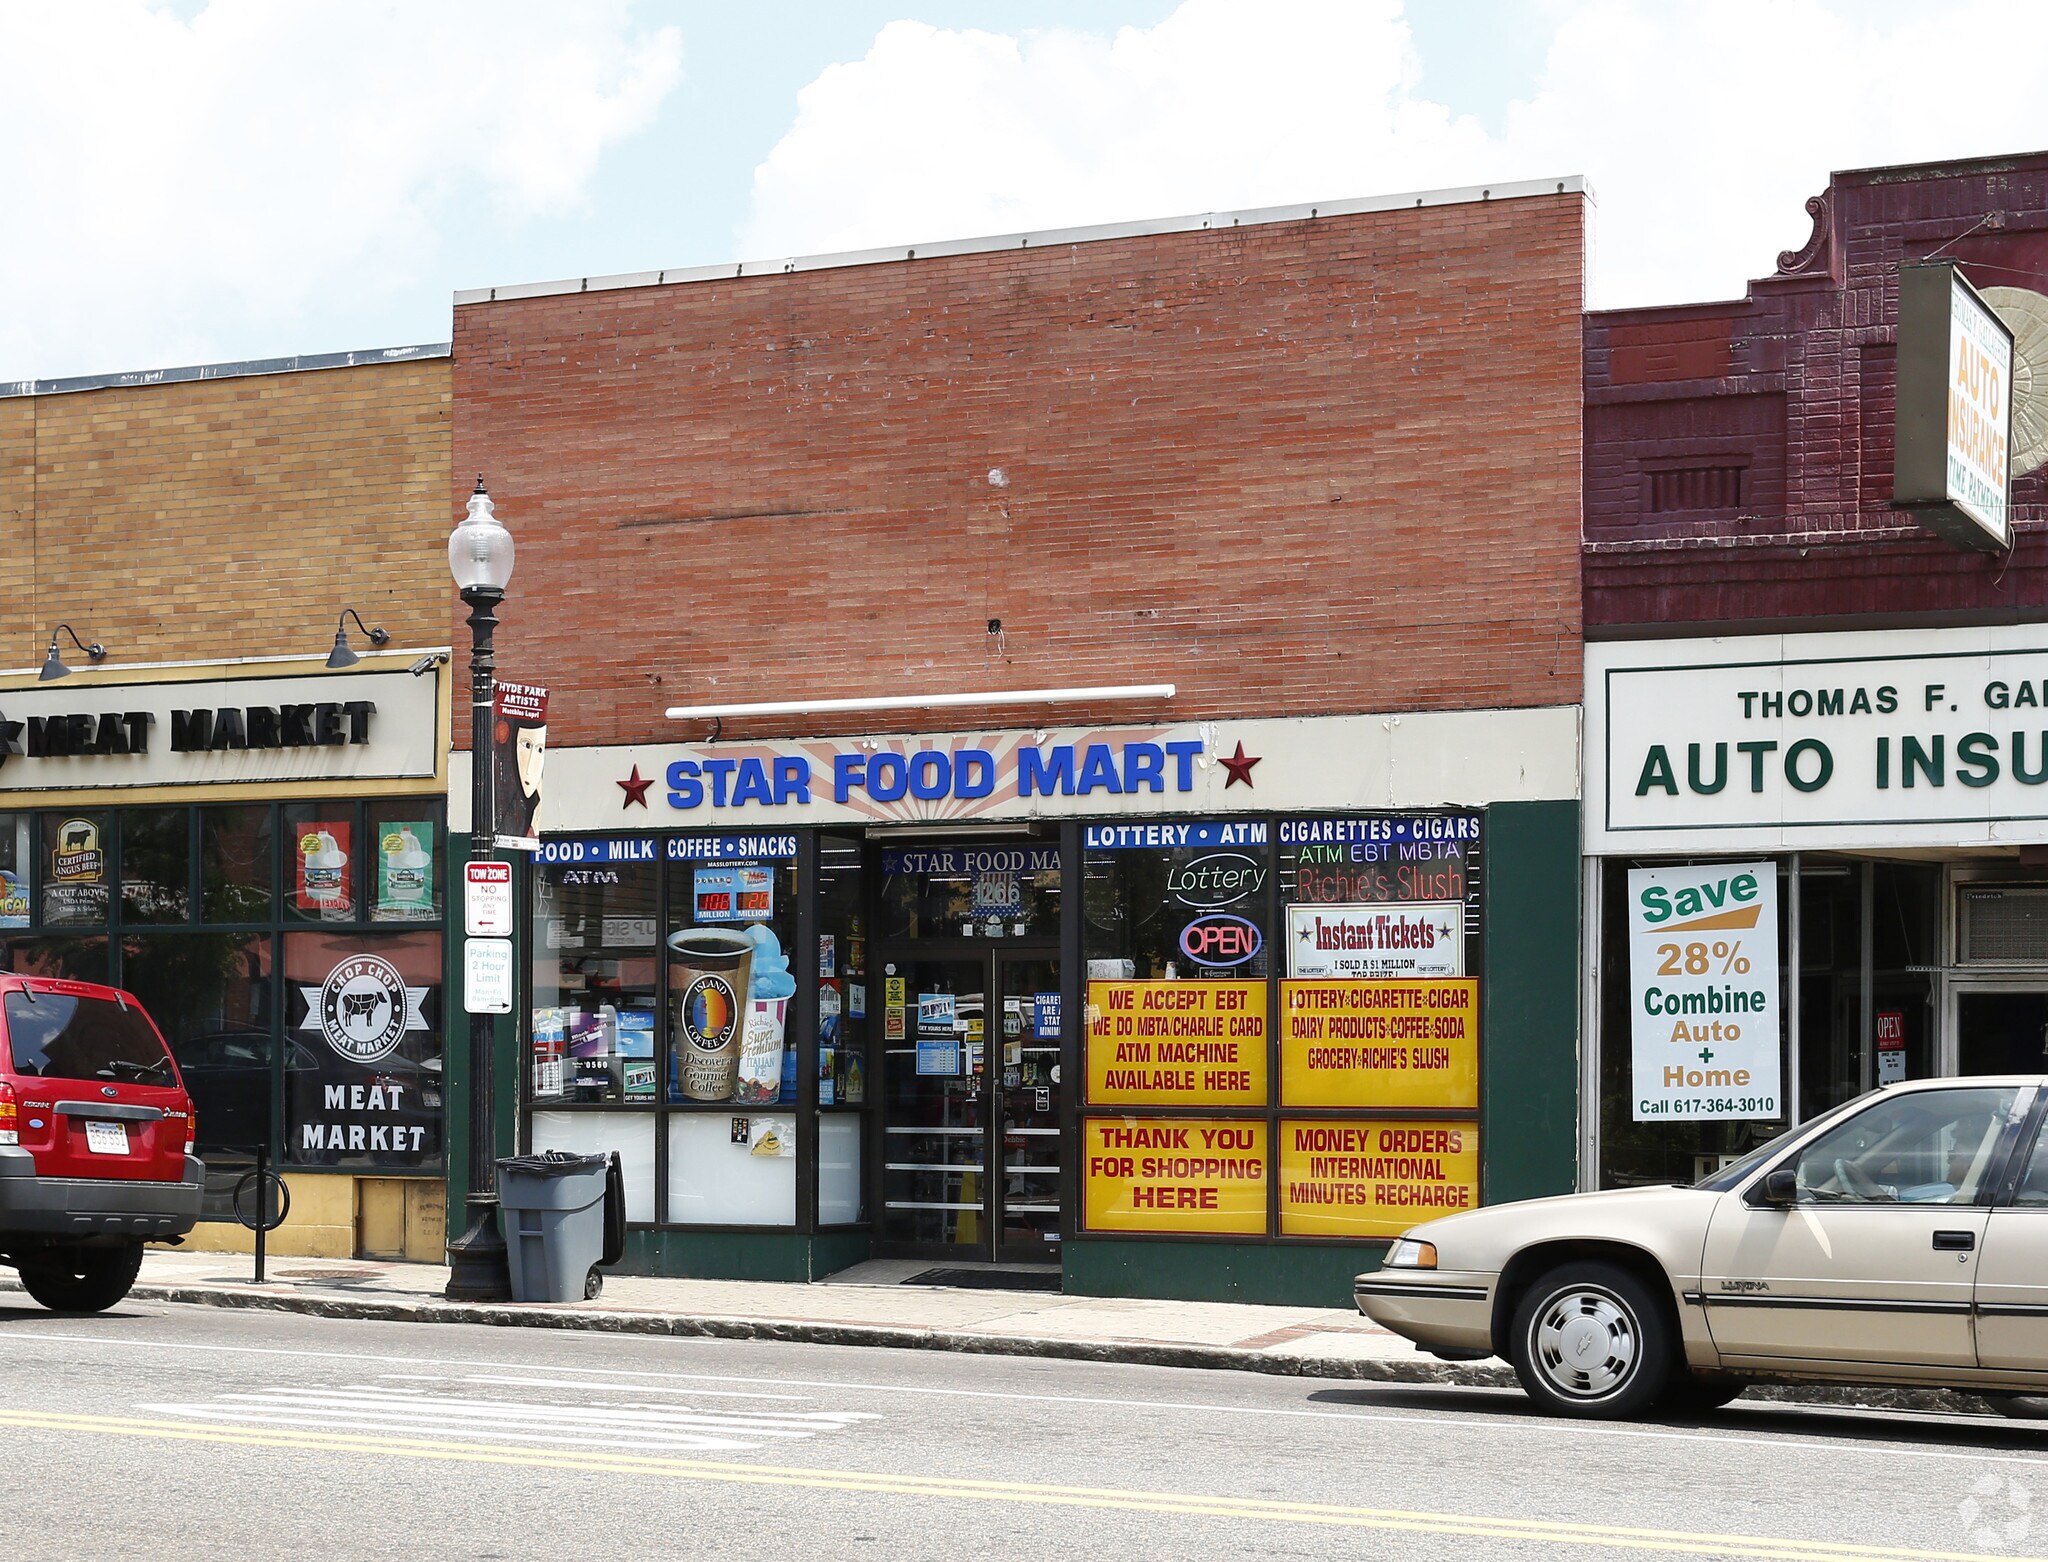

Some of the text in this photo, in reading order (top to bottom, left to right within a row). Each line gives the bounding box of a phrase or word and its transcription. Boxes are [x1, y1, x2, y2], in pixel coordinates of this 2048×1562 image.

[1958, 335, 2000, 422] AUTO
[1948, 387, 2004, 489] INSURANCE
[1949, 455, 2003, 527] TIME PAYMENTS
[498, 682, 547, 698] HYDE PARK
[504, 694, 540, 707] ARTISTS
[1738, 685, 1898, 718] THOMAS
[1924, 684, 1958, 712] F.
[27, 700, 377, 758] MEAT MARKET
[666, 740, 1204, 809] STAR FOOD MART
[1635, 738, 1834, 796] AUTO
[1087, 823, 1267, 846] LOTTERY ATM
[1280, 818, 1480, 842] CIGARETTES CIGARS
[535, 842, 584, 862] FOOD
[608, 840, 654, 860] MILK
[668, 836, 796, 858] COFFEE SNACKS
[1299, 841, 1460, 864] ATM EBT MBTA
[56, 864, 81, 876] ANGUS
[58, 852, 96, 866] CERTIFIED
[902, 854, 956, 874] STAR
[964, 852, 1025, 872] FOOD
[470, 868, 508, 880] TOW ZONE
[562, 870, 619, 884] ATM
[1166, 866, 1268, 892] Lottery
[1298, 864, 1463, 902] Richie's Slush
[52, 890, 58, 898] A
[58, 889, 77, 898] CUT
[481, 885, 497, 894] NO
[974, 882, 1020, 903] 1266
[1640, 873, 1758, 923] Save
[1185, 926, 1254, 954] OPEN
[1315, 914, 1435, 950] Instant Tickets
[470, 949, 508, 960] Parking
[472, 961, 505, 970] 2 Hour
[1334, 959, 1416, 970] I SOLD A $1 MILLION
[1656, 940, 1751, 976] 28%
[330, 964, 398, 994] CHOP CHOP
[476, 973, 501, 982] Limit
[694, 978, 728, 996] ISLAND
[1108, 990, 1248, 1010] WE ACCEPT EBT
[1428, 988, 1469, 1008] CIGAR
[1644, 984, 1766, 1016] Combine
[748, 1015, 773, 1028] Richie's
[1042, 1006, 1056, 1016] ARE
[327, 1018, 400, 1054] MEAT MARKET
[688, 1024, 720, 1048] COFFEE
[746, 1028, 774, 1046] Super
[1093, 1016, 1110, 1036] WE
[1116, 1016, 1133, 1036] DO
[1229, 1016, 1263, 1037] CARD
[1292, 1016, 1324, 1038] DAIRY
[1434, 1017, 1465, 1038] SODA
[1670, 1020, 1741, 1043] Auto
[1878, 1016, 1900, 1038] OPEN
[684, 1052, 726, 1066] Discover
[741, 1038, 782, 1058] Premium
[1116, 1043, 1238, 1063] ATM MACHINE
[1412, 1048, 1449, 1070] SLUSH
[683, 1066, 730, 1080] Gourmet
[746, 1058, 775, 1068] ITALIAN
[754, 1068, 767, 1077] ICE
[690, 1080, 724, 1093] Coffee
[1105, 1070, 1250, 1091] AVAILABLE HERE
[1663, 1066, 1750, 1088] Home
[324, 1084, 404, 1111] MEAT
[1640, 1096, 1774, 1114] Call 617-364-3010
[302, 1124, 426, 1152] MARKET
[1100, 1128, 1254, 1150] THANK YOU
[1295, 1128, 1462, 1154] MONEY ORDERS
[1090, 1157, 1262, 1180] FOR SHOPPING
[1310, 1157, 1446, 1180] INTERNATIONAL
[1133, 1186, 1218, 1210] HERE
[1290, 1182, 1469, 1208] MINUTES RECHARGE
